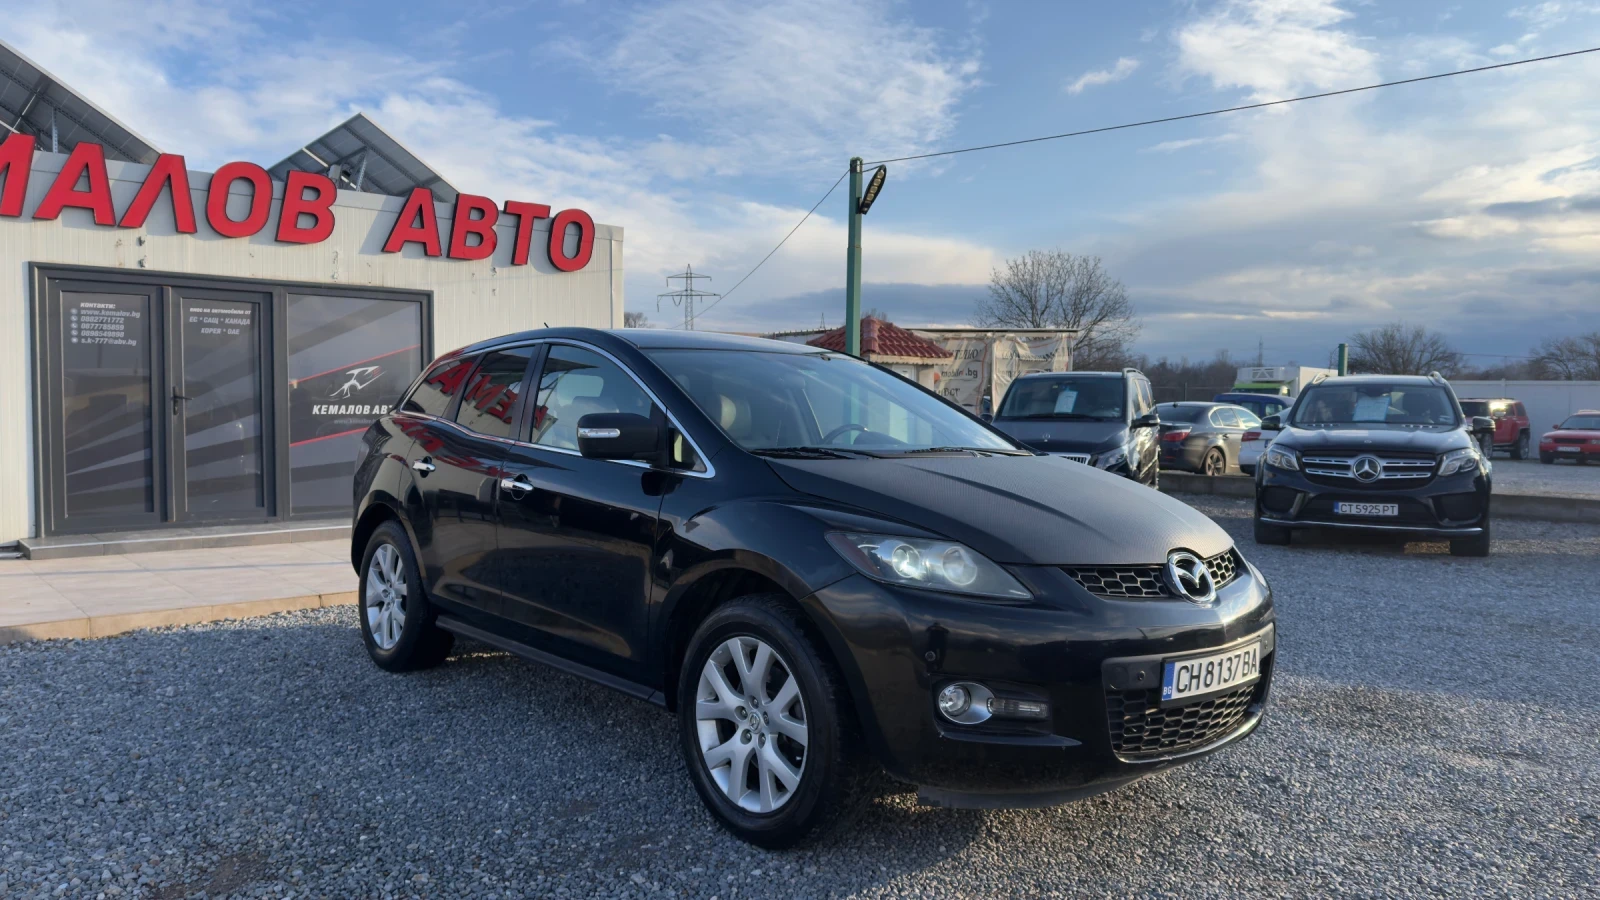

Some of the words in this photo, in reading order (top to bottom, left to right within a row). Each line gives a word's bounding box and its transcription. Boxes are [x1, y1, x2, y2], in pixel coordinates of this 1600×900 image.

[381, 187, 595, 272] АВТО
[80, 315, 125, 323] 0882771772
[312, 404, 371, 415] КЕМАЛОВ
[1340, 504, 1353, 513] CT
[1355, 504, 1381, 514] 5925
[1382, 505, 1396, 515] PT
[1176, 662, 1203, 693] CH
[1204, 653, 1241, 688] 8137
[1242, 648, 1257, 678] BA
[1163, 686, 1172, 696] BG
